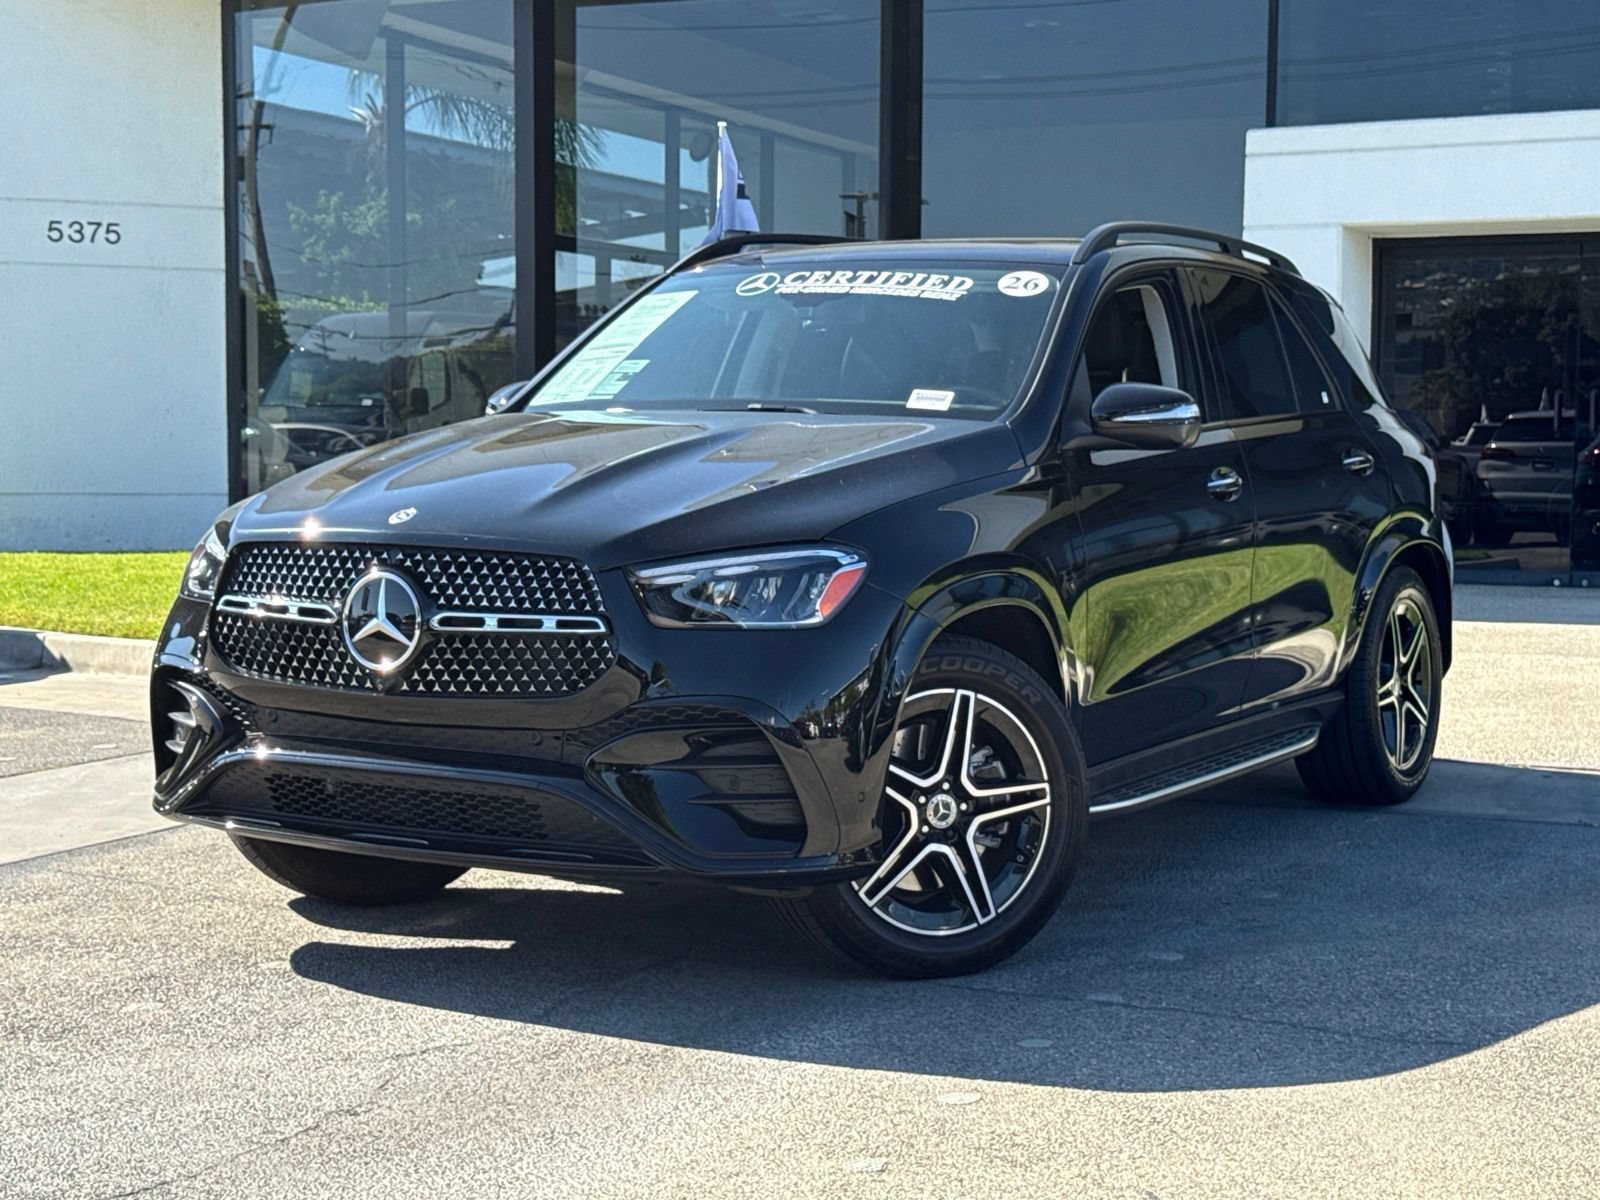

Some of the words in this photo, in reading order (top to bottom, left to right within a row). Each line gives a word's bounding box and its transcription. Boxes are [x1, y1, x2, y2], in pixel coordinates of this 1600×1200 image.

[47, 220, 121, 245] 5375
[783, 270, 974, 291] CERTIFIED
[1003, 276, 1041, 291] 26
[919, 655, 1043, 705] COOPER
